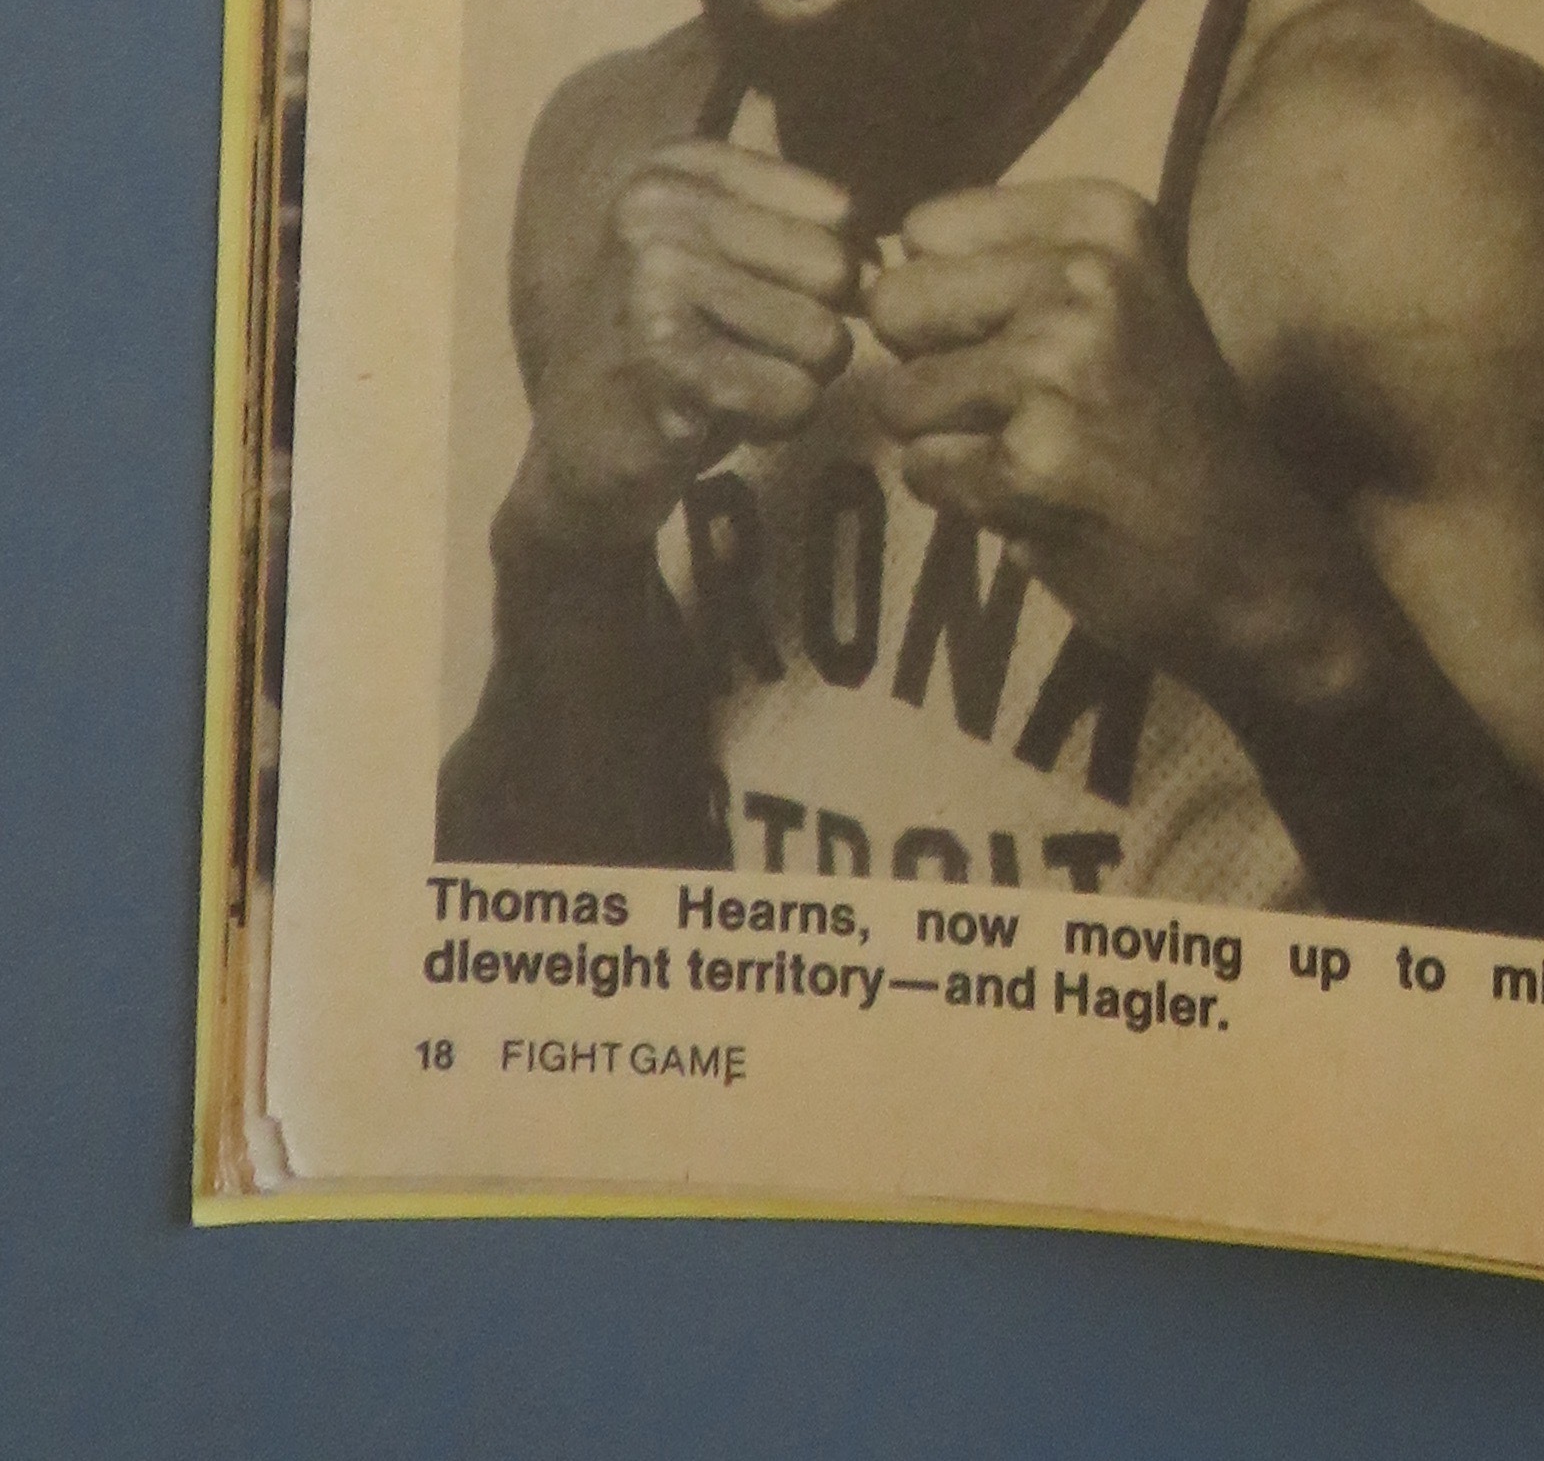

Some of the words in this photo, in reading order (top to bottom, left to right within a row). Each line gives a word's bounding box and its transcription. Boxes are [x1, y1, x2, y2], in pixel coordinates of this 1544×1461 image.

[426, 876, 630, 927] Thomas
[678, 885, 870, 946] Hearns,
[917, 909, 1019, 948] now
[1065, 919, 1243, 983] moving
[1289, 943, 1352, 992] up
[1395, 945, 1447, 993] to
[423, 938, 671, 999] dleweight
[1054, 970, 1229, 1034] Hagler.
[415, 1038, 455, 1071] 18
[501, 1039, 623, 1073] FIGHT
[629, 1042, 747, 1087] GAME
